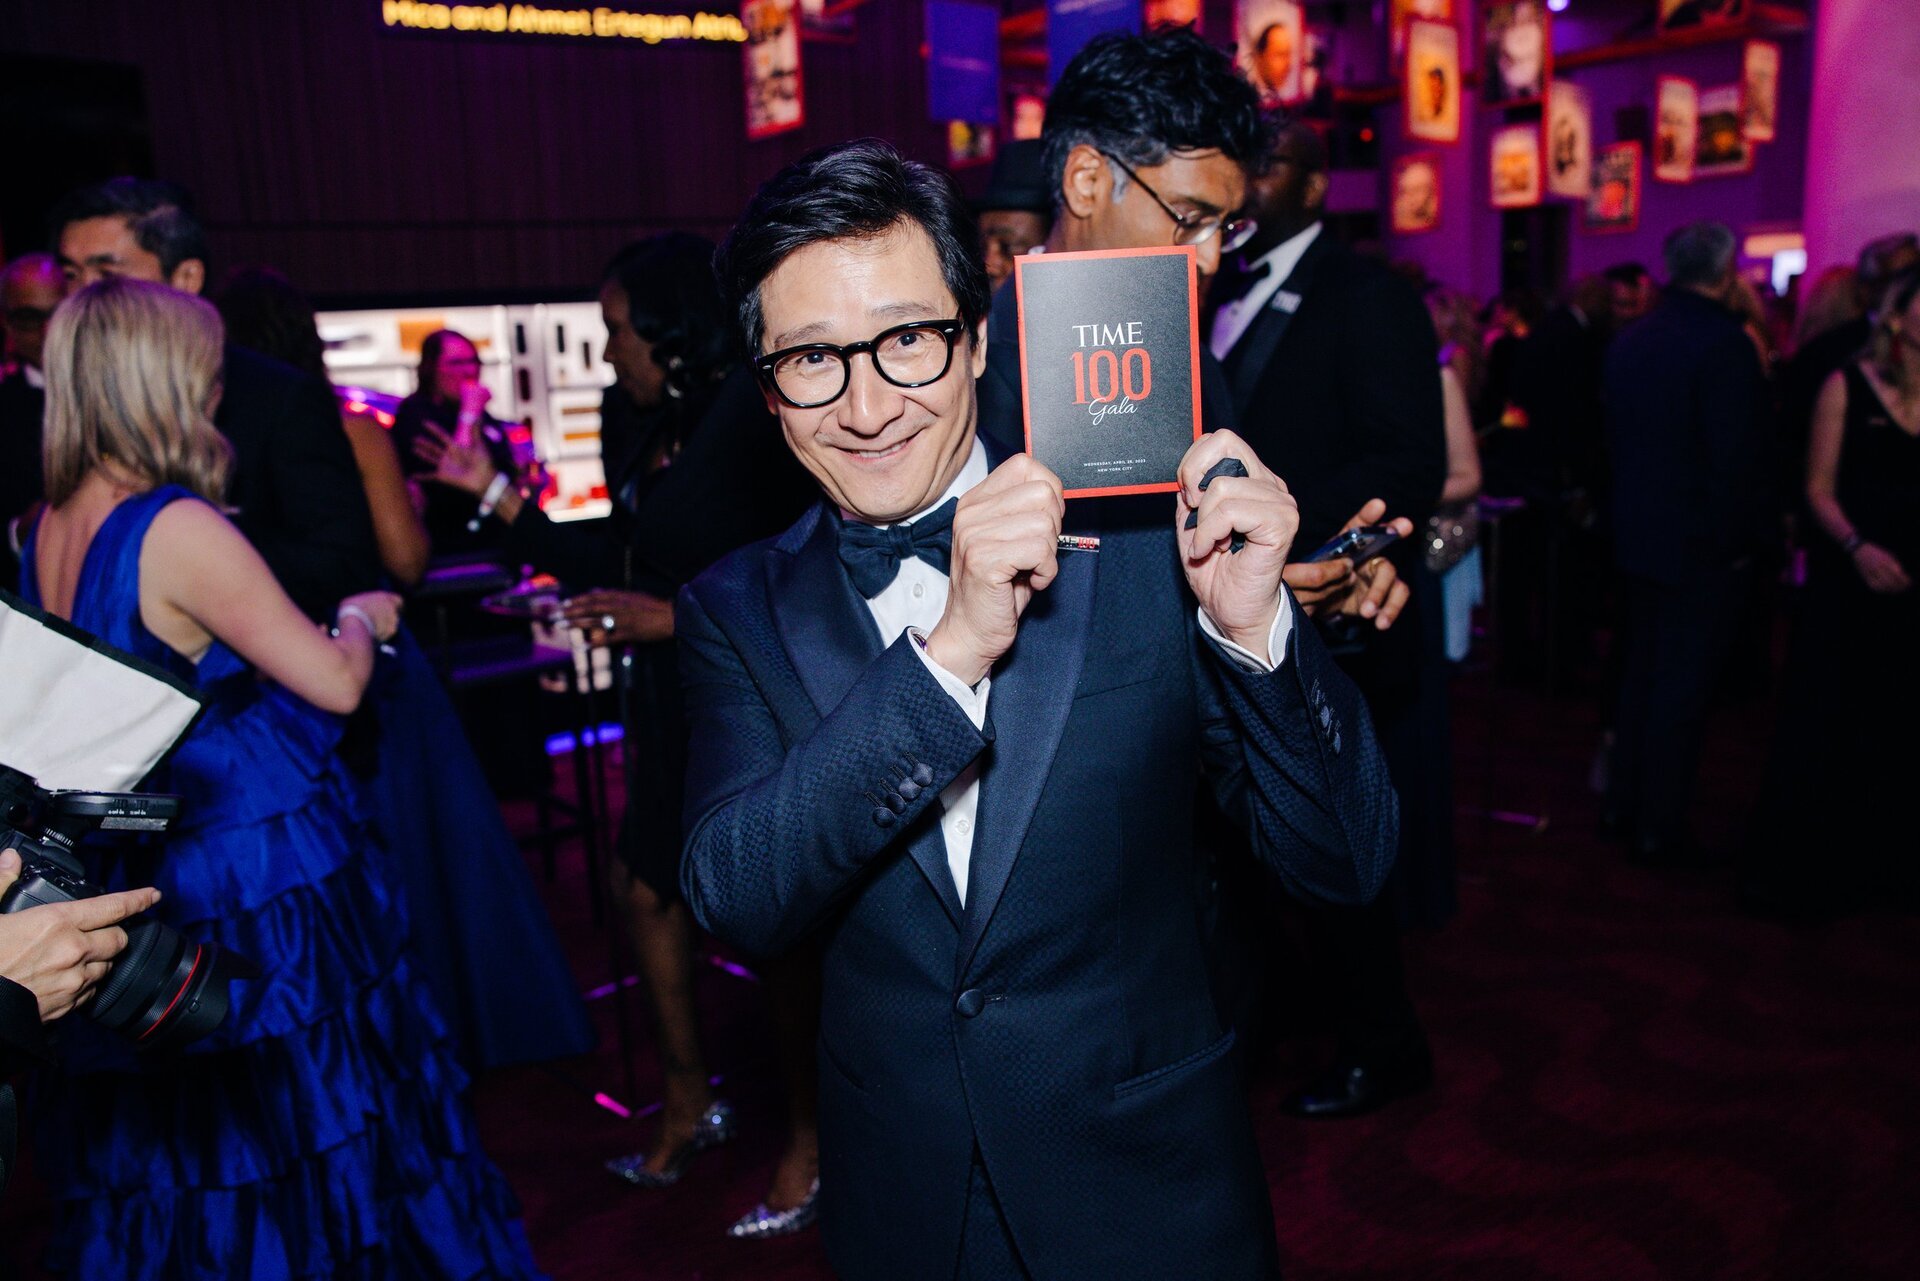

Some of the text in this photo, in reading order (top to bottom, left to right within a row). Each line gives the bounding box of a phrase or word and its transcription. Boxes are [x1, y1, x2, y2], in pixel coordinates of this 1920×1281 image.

[451, 3, 508, 32] and
[508, 4, 591, 36] Ahmet
[1072, 322, 1144, 347] TIME
[1070, 347, 1152, 404] 100
[1088, 396, 1138, 425] Gala
